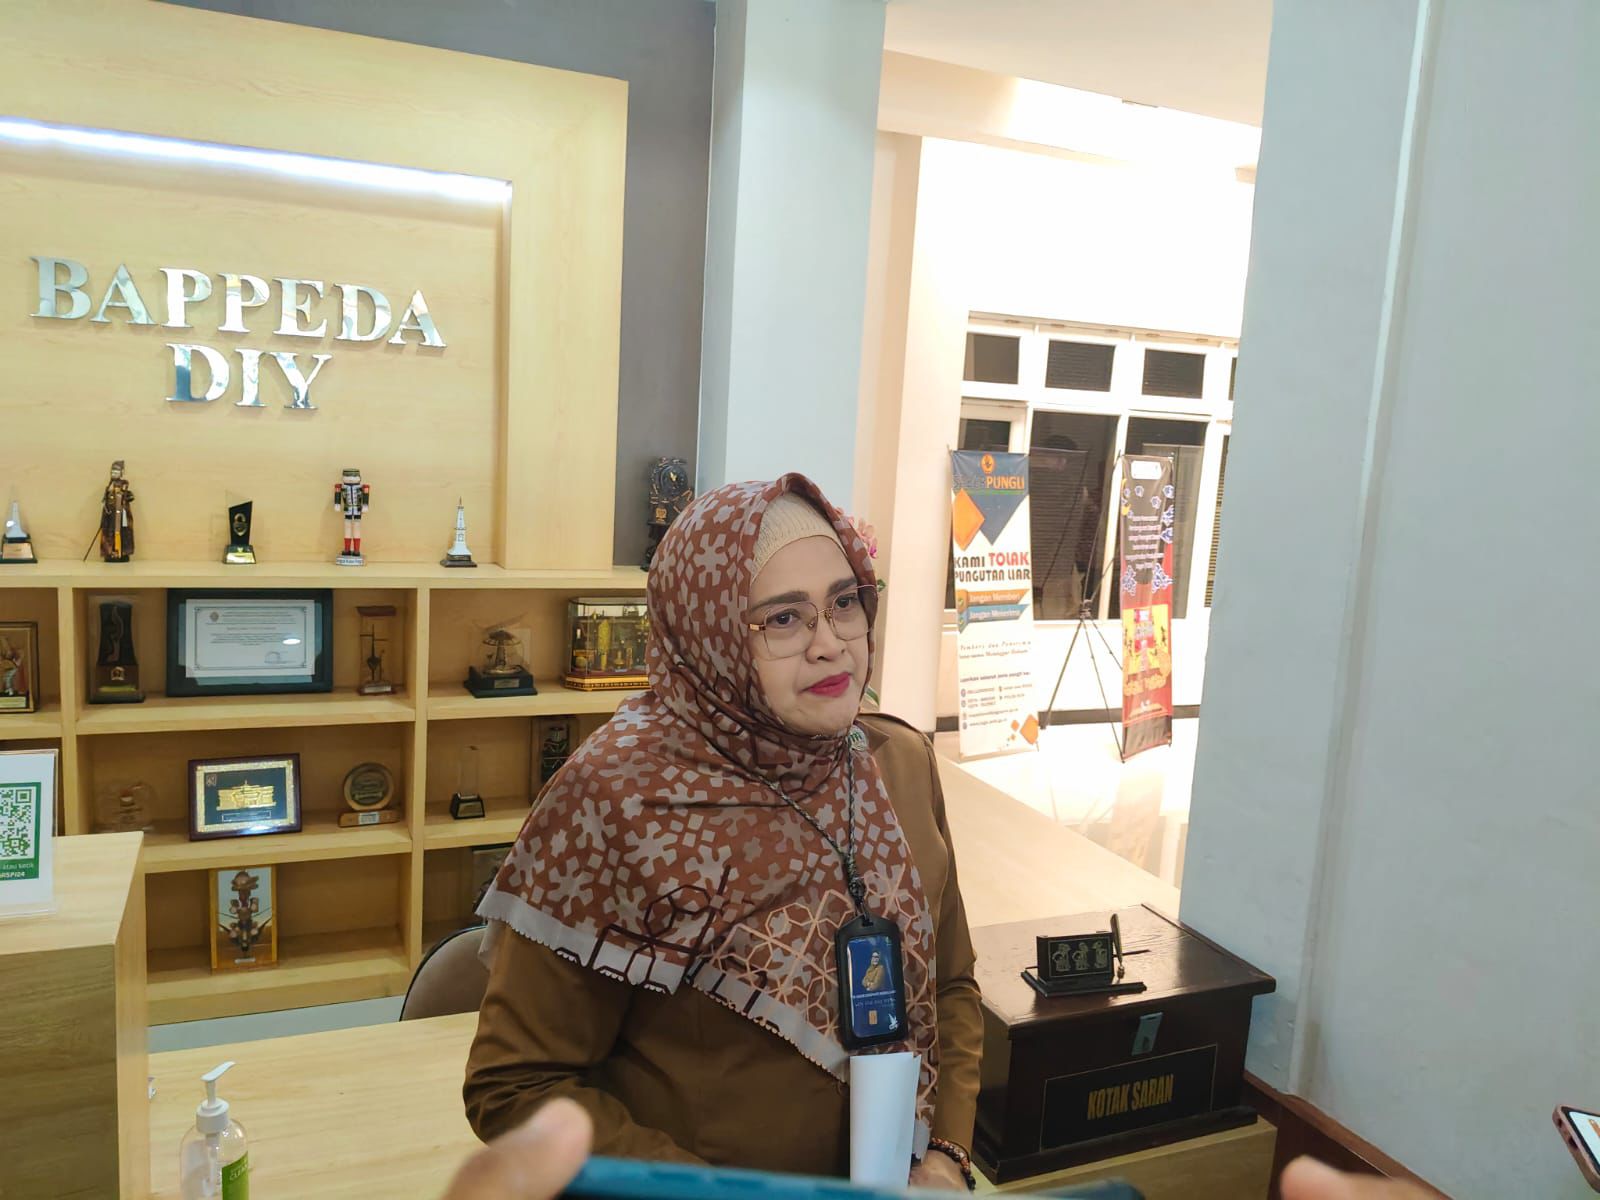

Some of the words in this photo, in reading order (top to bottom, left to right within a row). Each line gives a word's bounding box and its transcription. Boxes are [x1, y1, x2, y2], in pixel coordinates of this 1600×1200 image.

[30, 256, 447, 348] BAPPEDA
[165, 343, 333, 411] DIY
[954, 556, 985, 568] KAMI
[988, 551, 1030, 566] TOLAK
[1007, 568, 1031, 580] LIAR
[1087, 1084, 1130, 1120] KOTAK
[1131, 1074, 1174, 1110] SARAN
